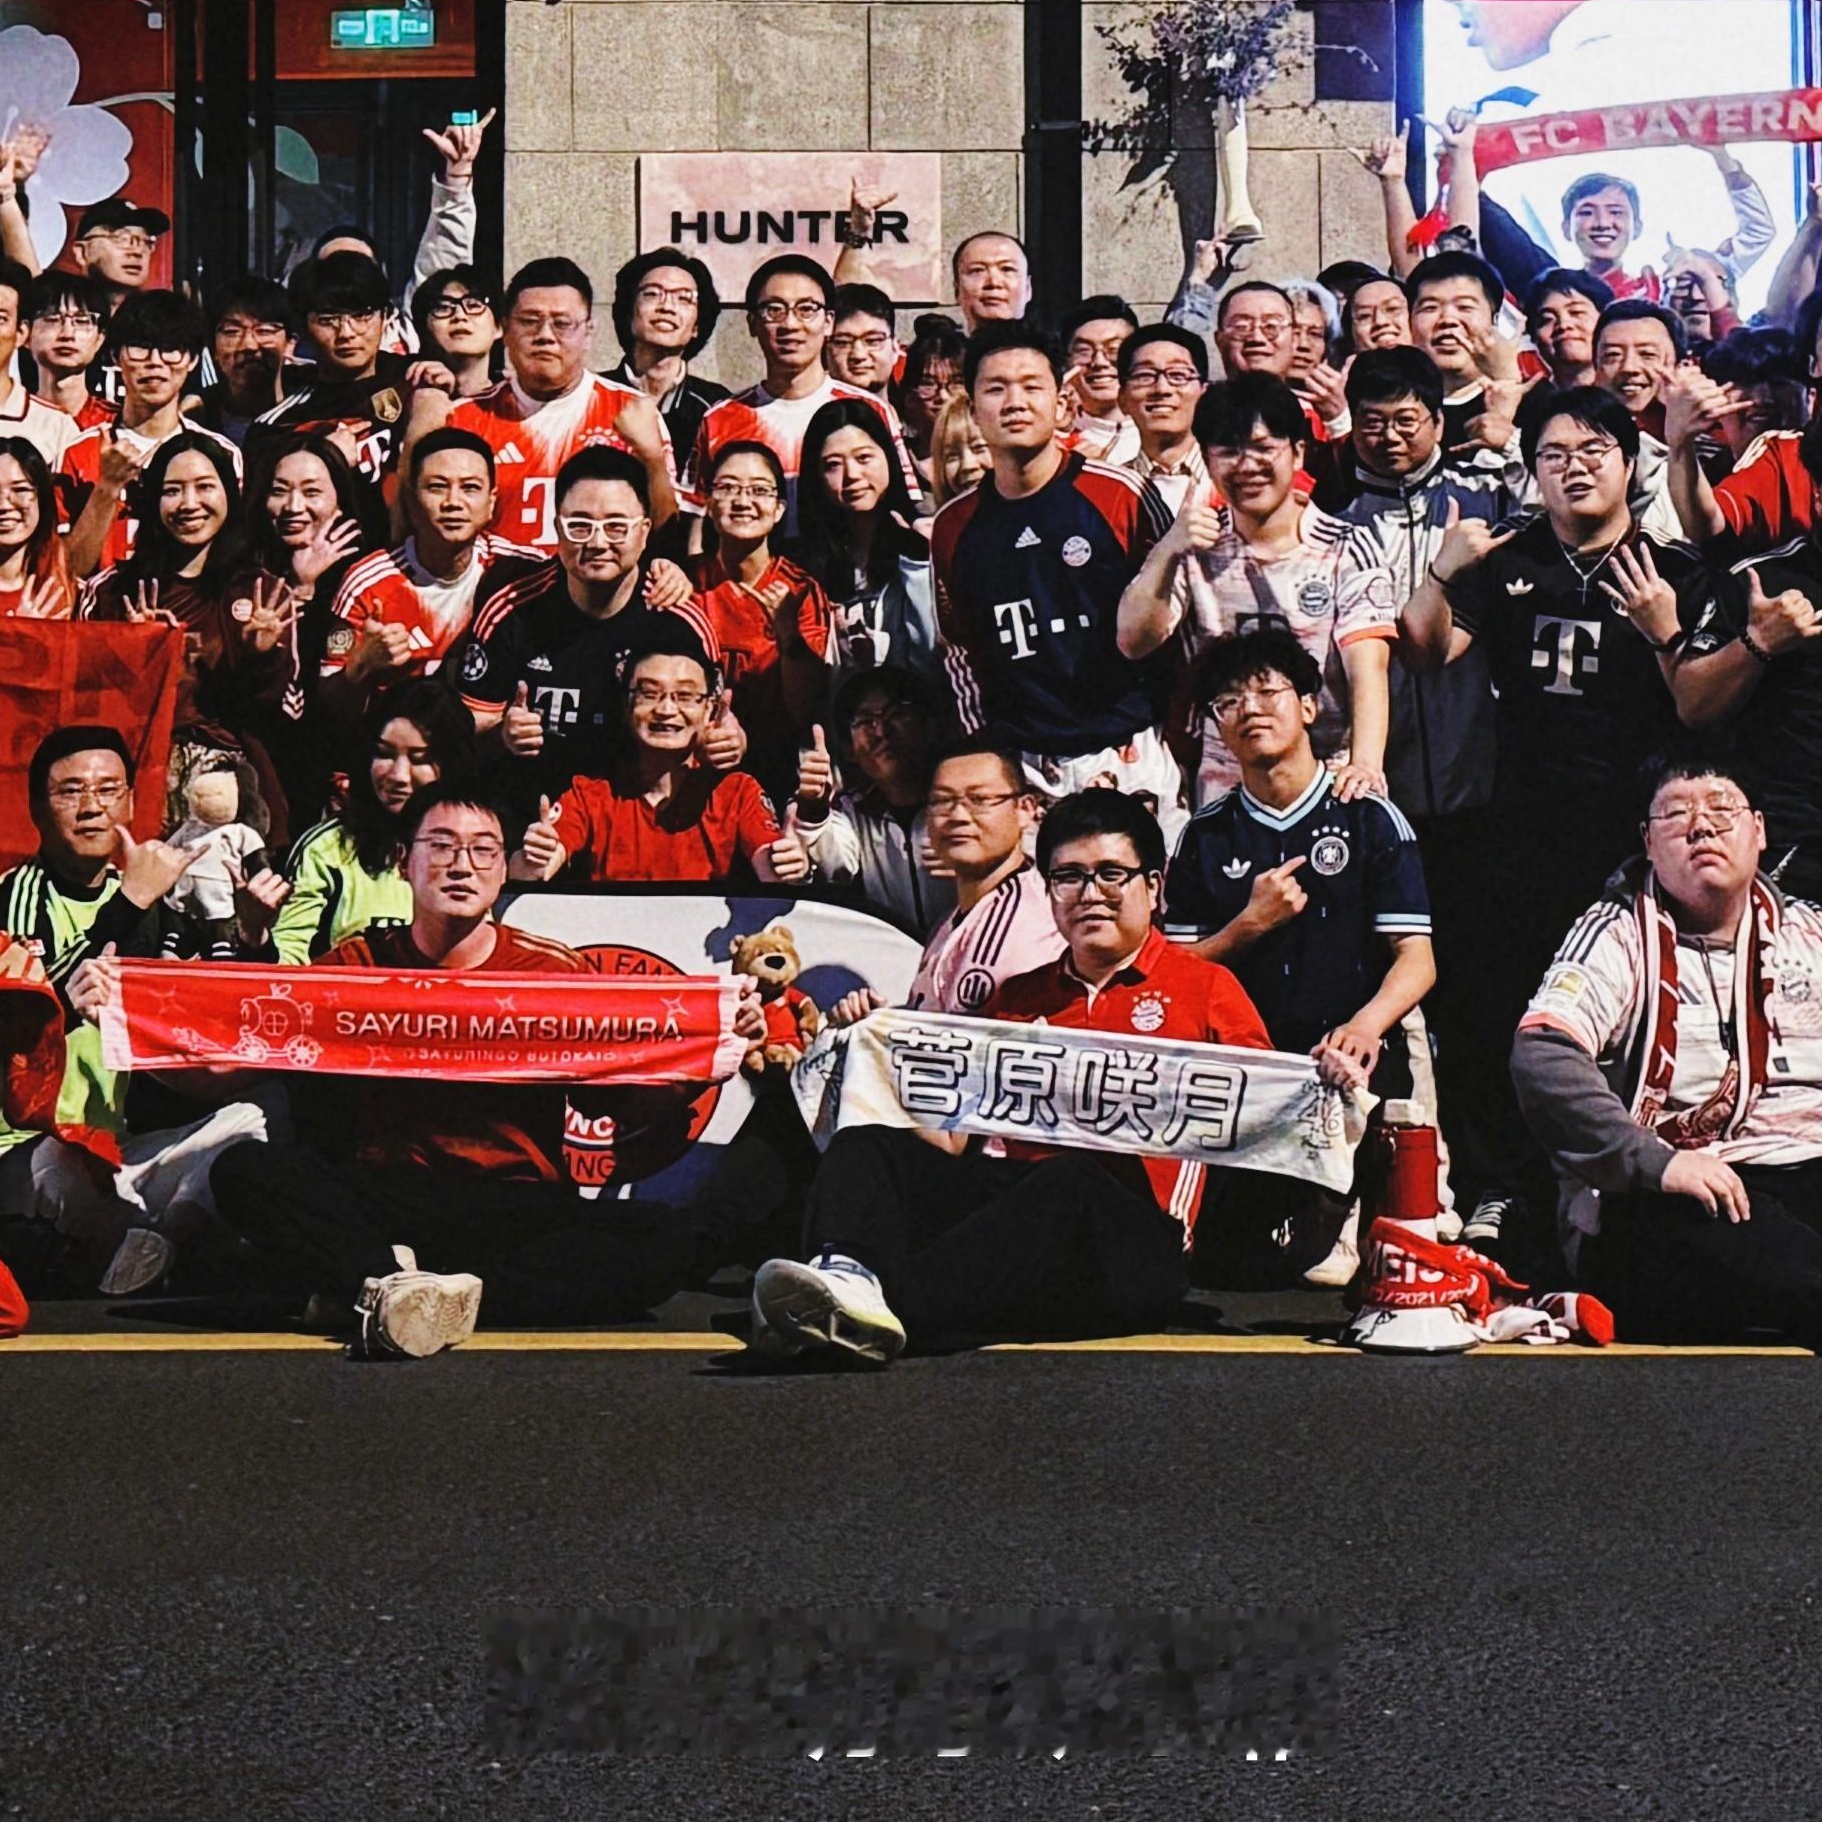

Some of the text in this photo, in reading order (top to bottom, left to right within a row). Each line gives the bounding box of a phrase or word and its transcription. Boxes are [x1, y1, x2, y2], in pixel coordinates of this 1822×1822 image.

[1511, 118, 1580, 154] FC
[994, 598, 1039, 660] T
[1532, 614, 1602, 696] T
[335, 1011, 683, 1042] SAYURI MATSUMURA
[890, 1028, 1247, 1152] 菅原咲月
